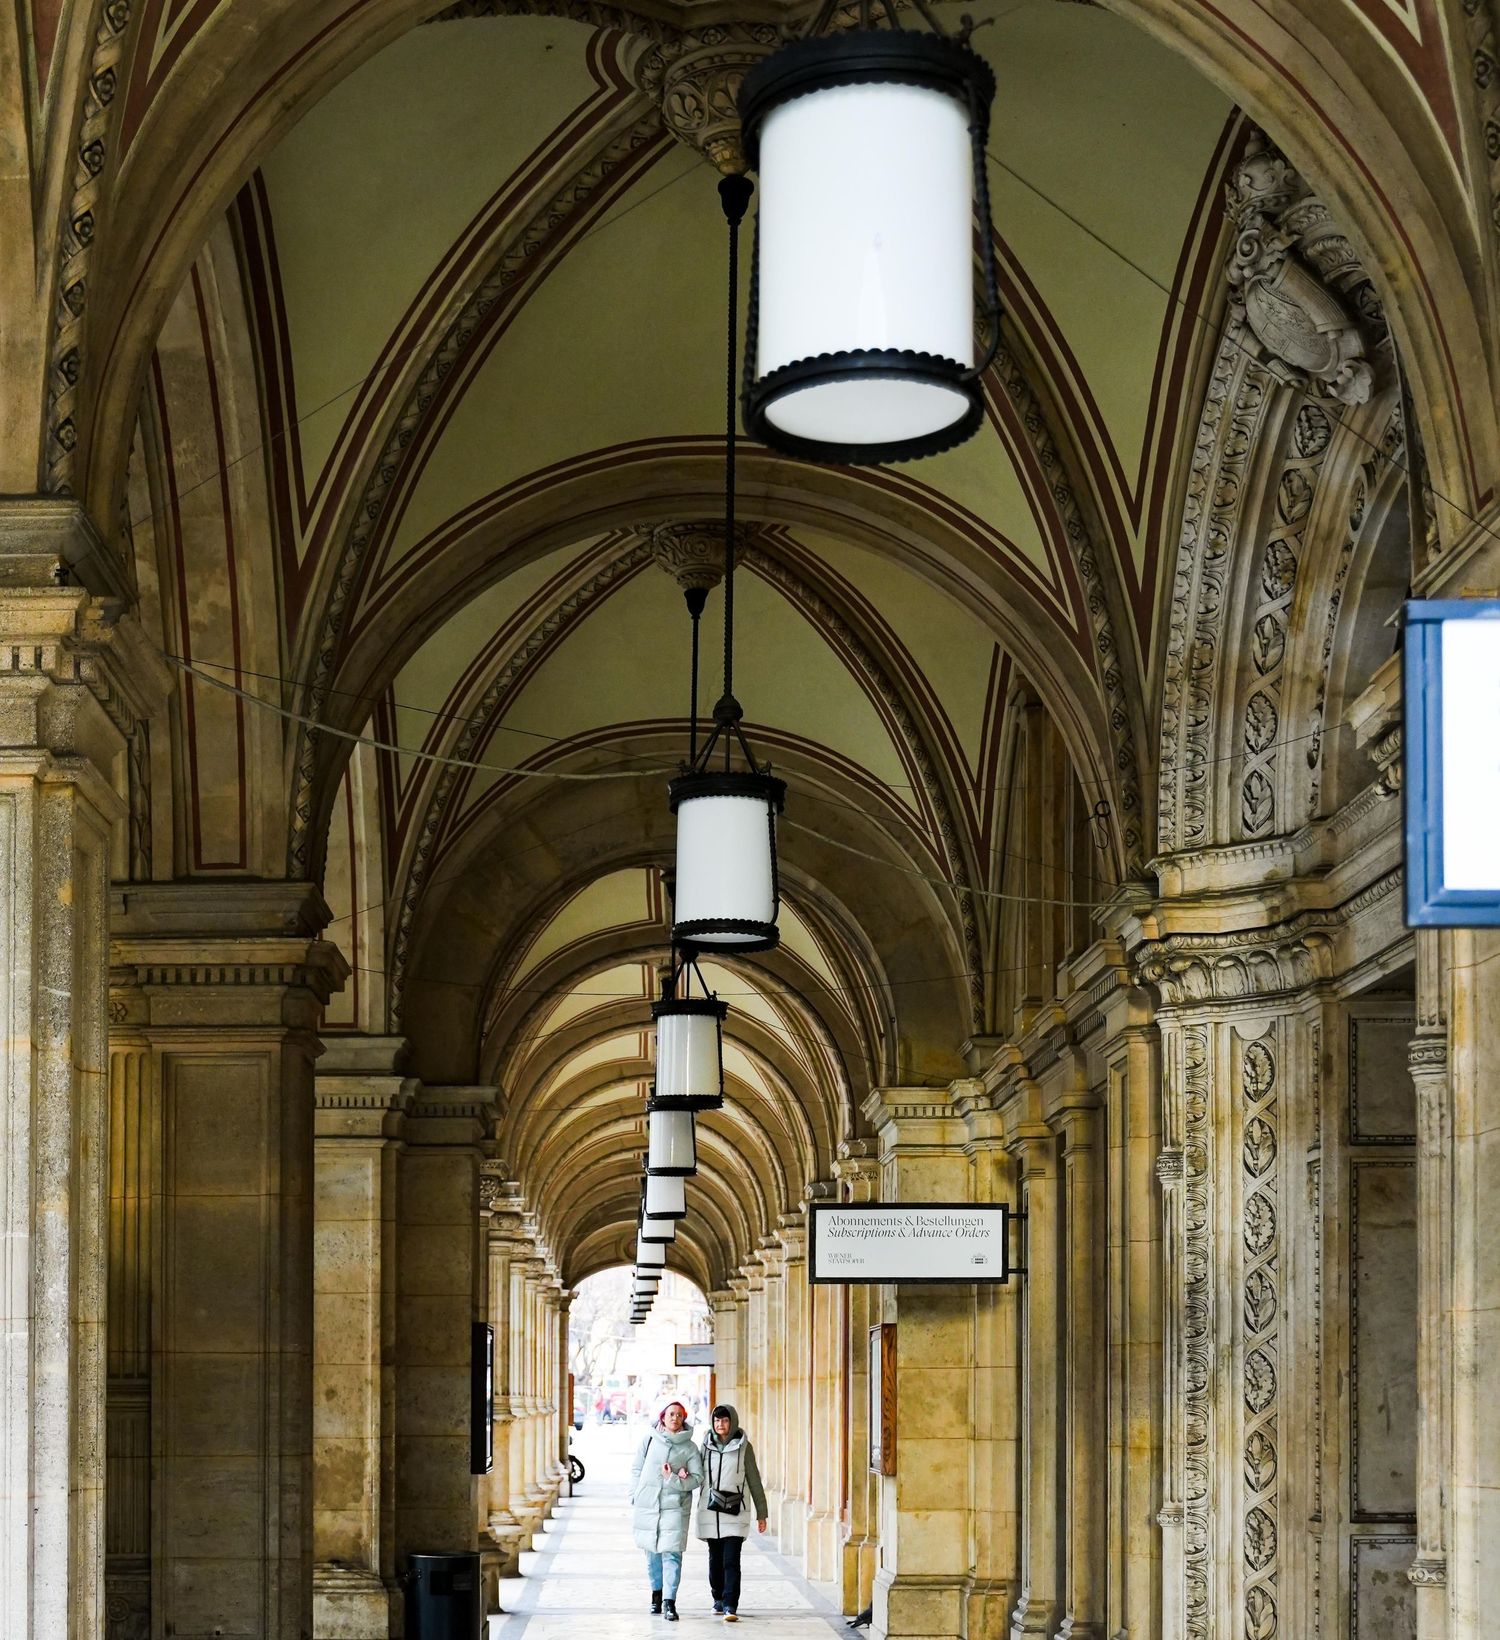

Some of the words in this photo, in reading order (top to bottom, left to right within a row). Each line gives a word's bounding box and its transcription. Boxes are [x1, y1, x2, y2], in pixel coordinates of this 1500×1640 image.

[828, 1215, 903, 1226] Abonnements
[905, 1215, 914, 1226] &
[916, 1215, 984, 1228] Bestellungen
[827, 1227, 896, 1239] Subscriptions
[898, 1227, 906, 1238] &
[909, 1227, 953, 1238] Advance
[955, 1227, 990, 1238] Orders
